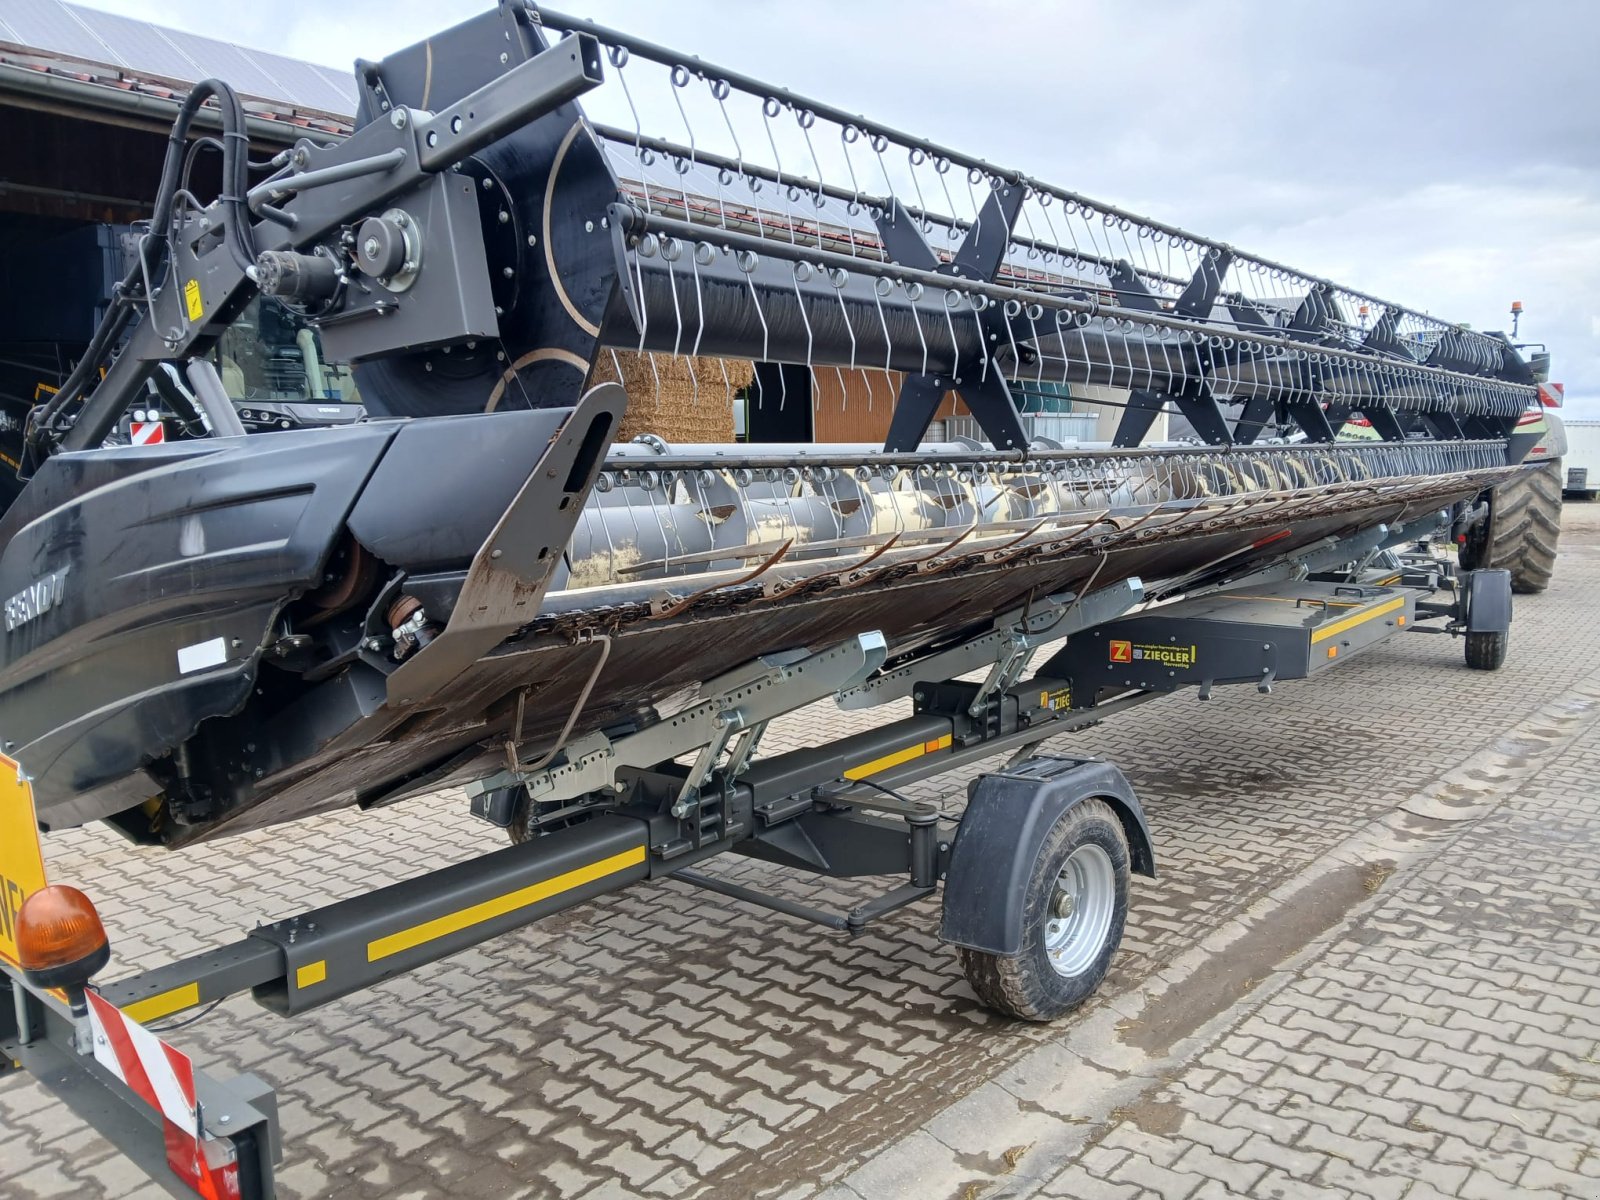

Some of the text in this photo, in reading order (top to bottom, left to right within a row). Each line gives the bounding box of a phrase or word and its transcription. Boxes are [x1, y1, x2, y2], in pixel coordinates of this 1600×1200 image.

[4, 564, 71, 632] FENDT
[1113, 643, 1127, 660] Z
[1143, 650, 1190, 663] ZIEGLER
